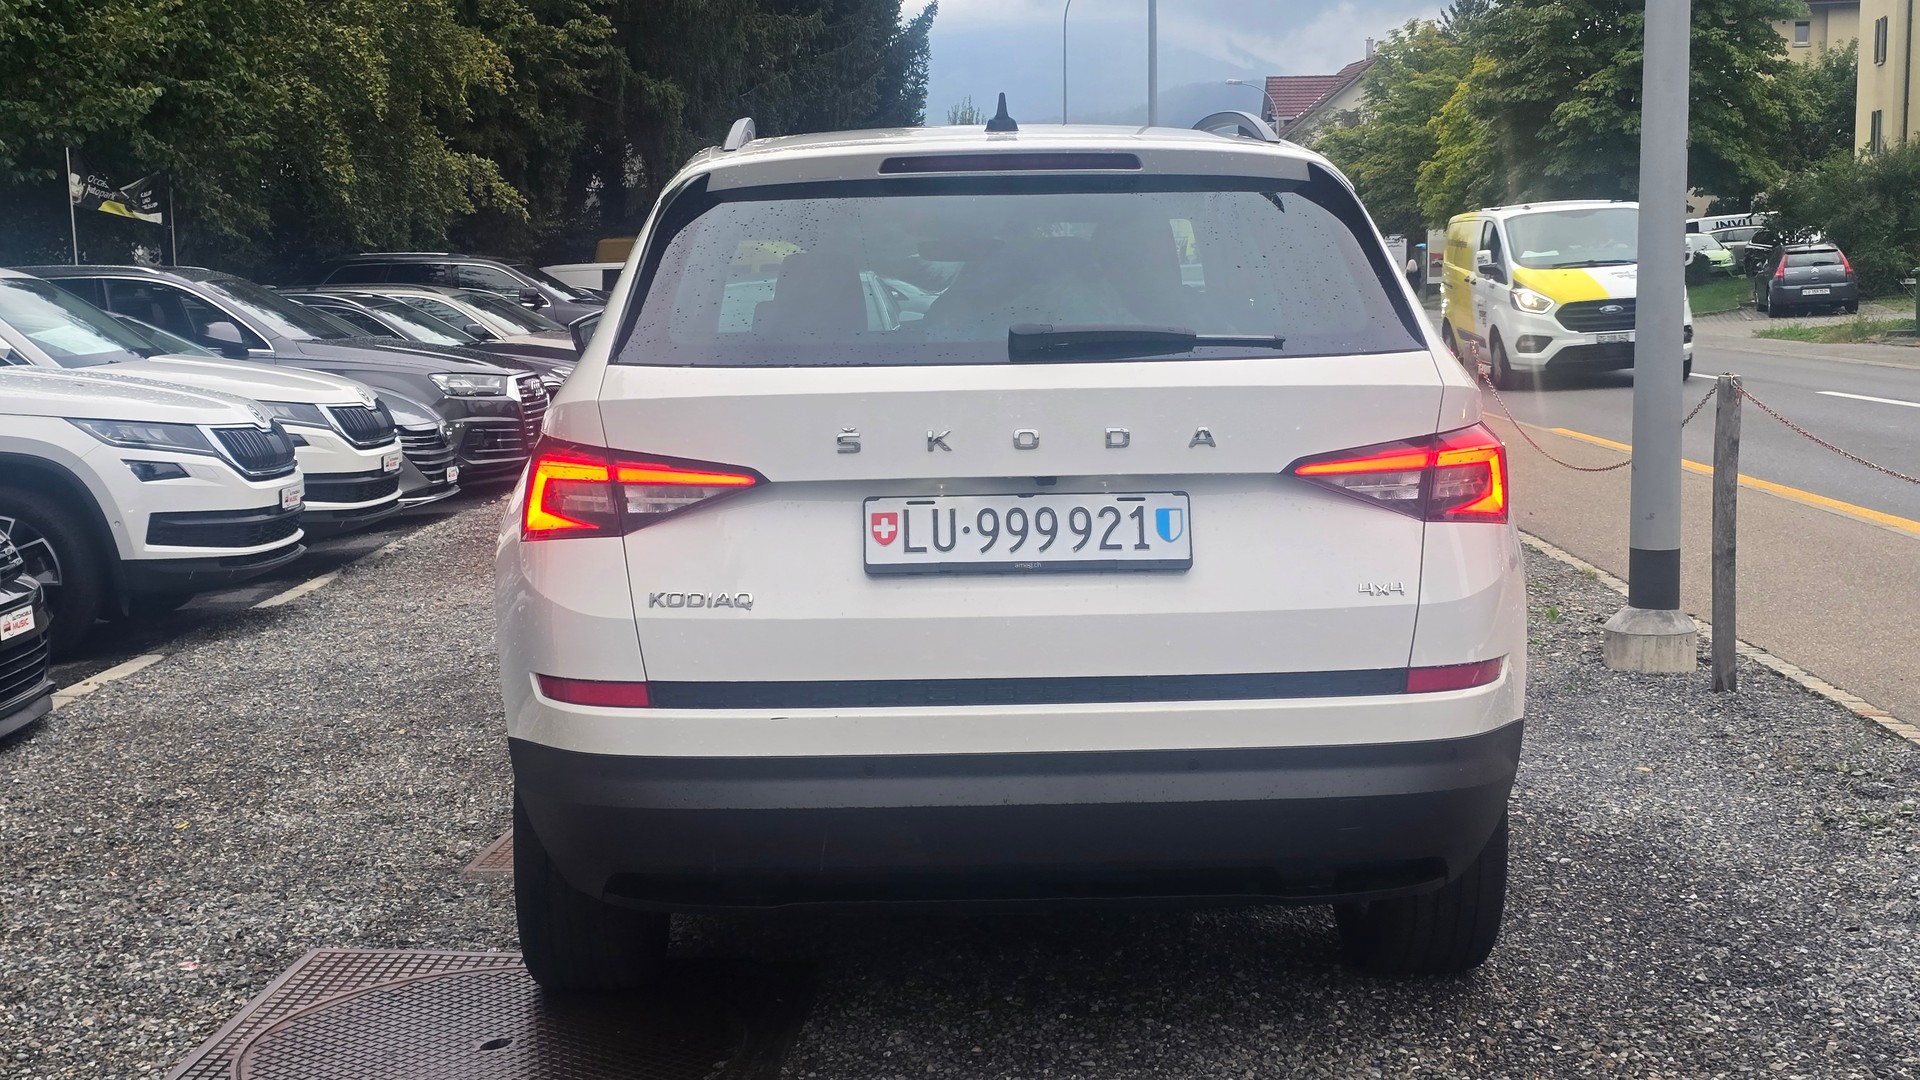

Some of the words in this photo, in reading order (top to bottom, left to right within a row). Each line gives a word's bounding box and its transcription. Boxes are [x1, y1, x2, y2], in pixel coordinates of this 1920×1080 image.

[836, 426, 1217, 454] ŠKODA
[1358, 582, 1405, 596] 4x4
[648, 592, 754, 611] KODIAQ
